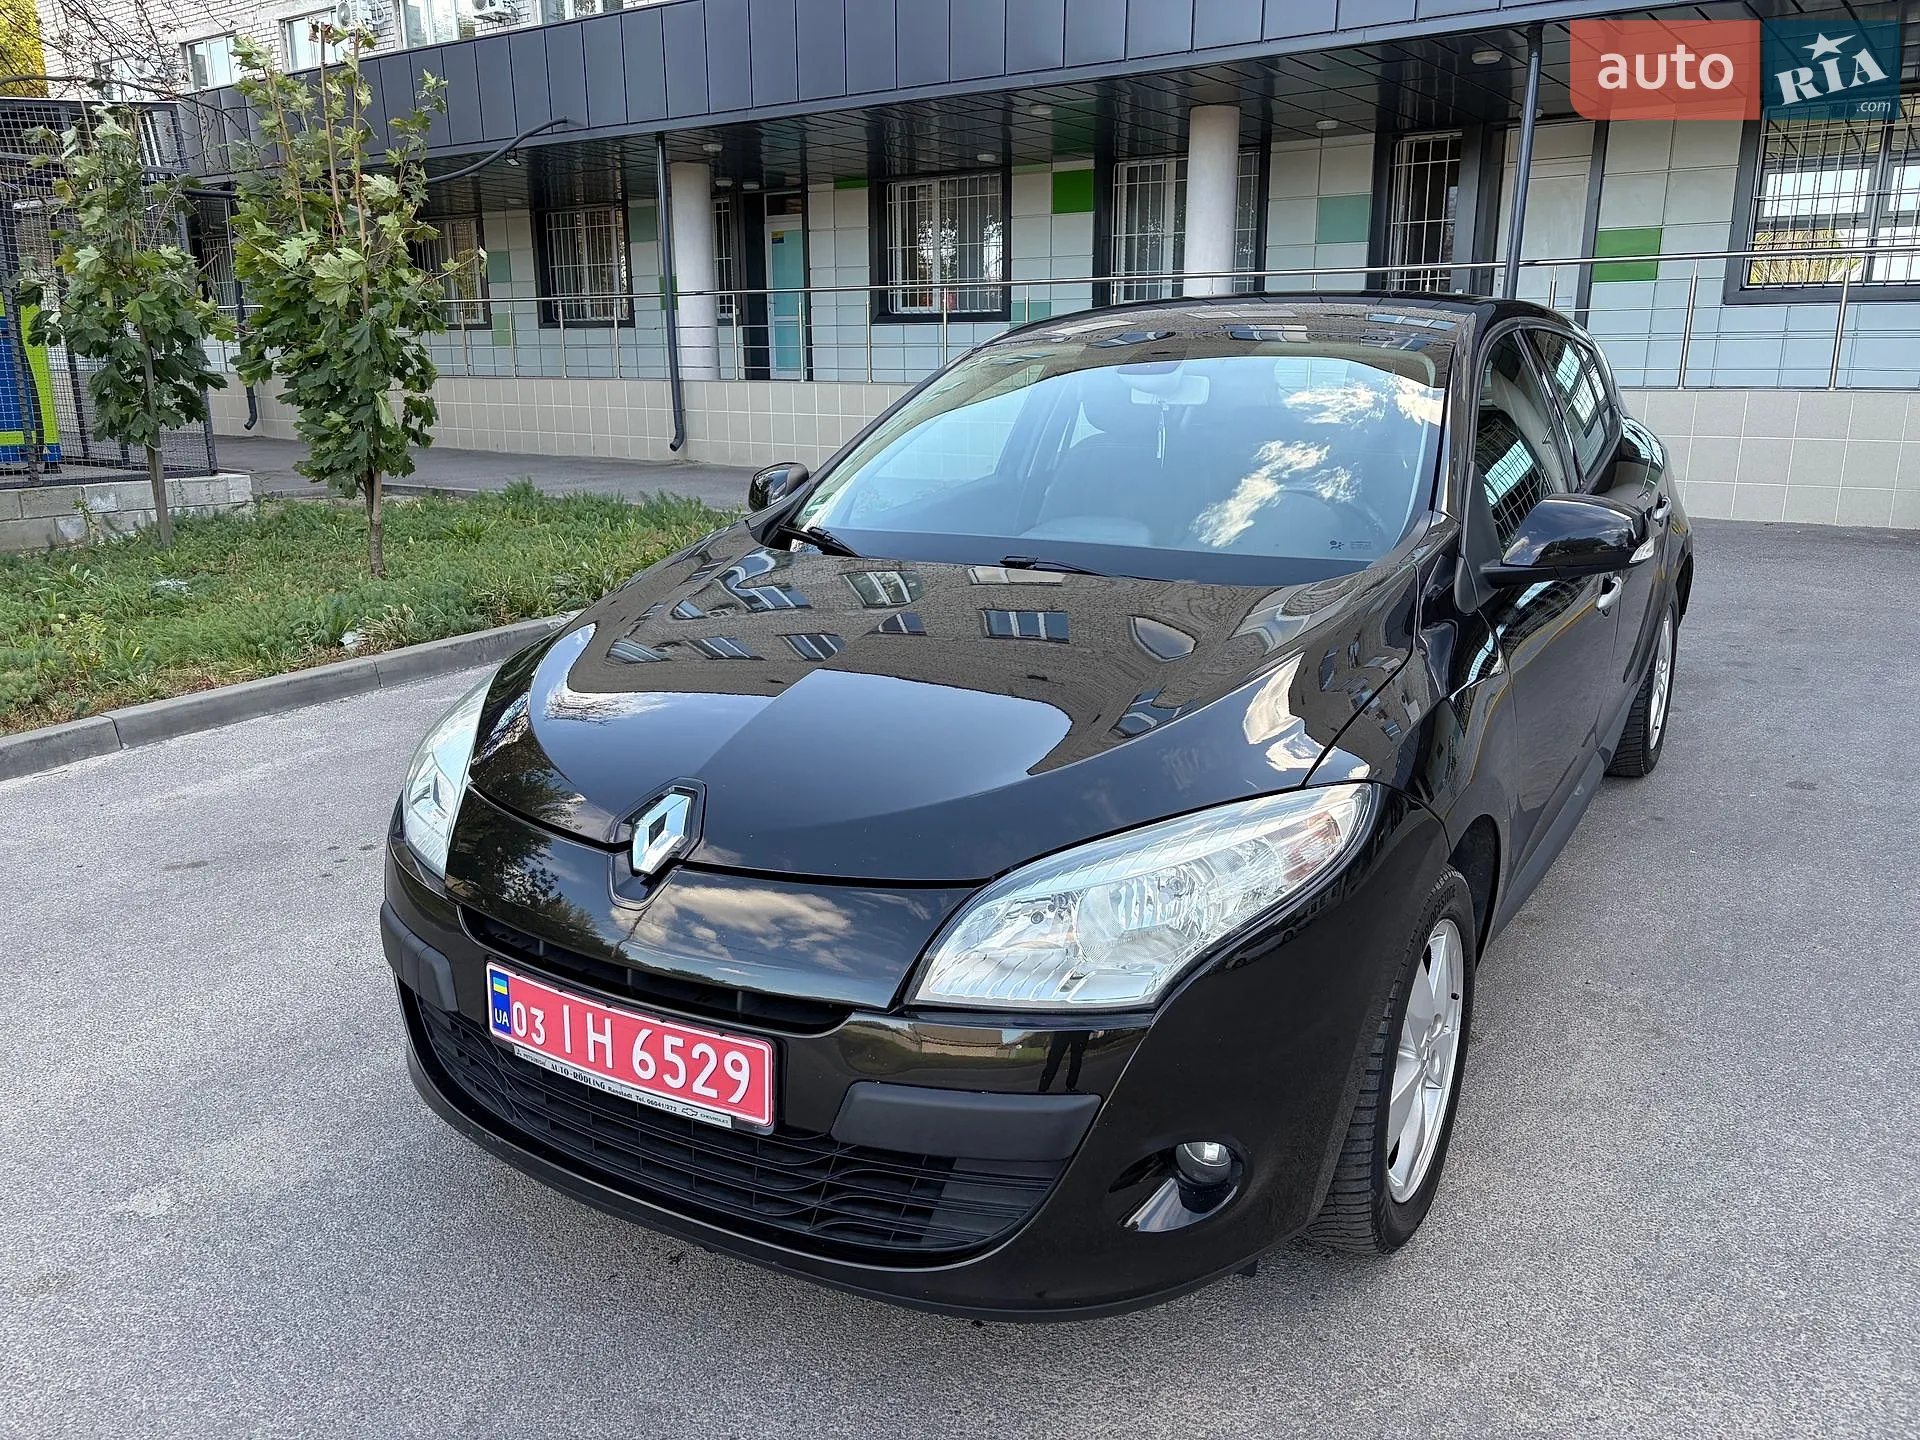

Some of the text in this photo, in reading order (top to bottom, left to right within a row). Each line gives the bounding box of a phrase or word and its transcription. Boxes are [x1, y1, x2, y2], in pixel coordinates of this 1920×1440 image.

[494, 1007, 509, 1027] UA
[512, 1001, 545, 1045] 03
[632, 1029, 750, 1103] 6529
